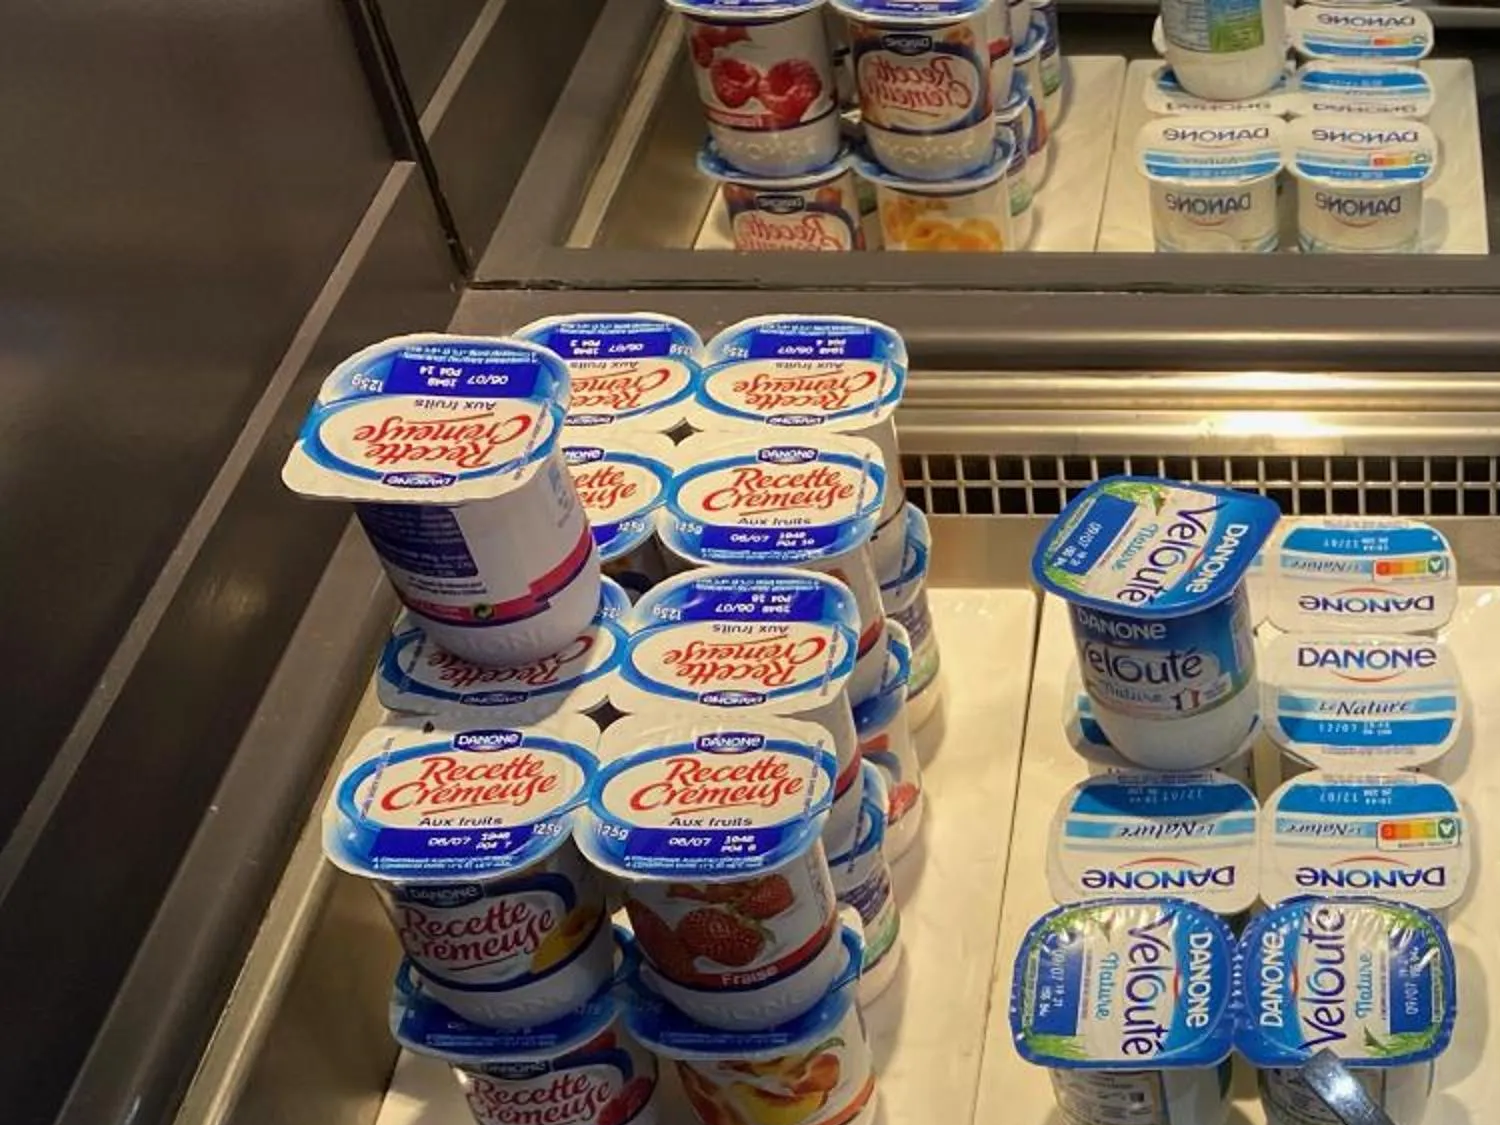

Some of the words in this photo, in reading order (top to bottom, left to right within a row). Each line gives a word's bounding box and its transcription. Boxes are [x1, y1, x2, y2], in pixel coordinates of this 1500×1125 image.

[745, 391, 851, 409] Recette
[365, 443, 494, 469] Recette
[731, 466, 840, 491] Recette
[1186, 523, 1249, 594] DANONE
[1299, 595, 1435, 613] DANONE
[1077, 607, 1167, 640] DANONE
[1297, 647, 1437, 669] DANONE
[676, 663, 797, 687] Recette
[1335, 700, 1411, 716] Nature
[415, 753, 545, 785] Recette
[664, 754, 791, 785] Recette
[1118, 823, 1203, 839] Nature
[1284, 822, 1351, 838] Nature
[1081, 866, 1235, 888] DANONE
[1295, 866, 1445, 888] DANONE
[398, 900, 528, 940] Recette
[721, 964, 779, 986] Fraise
[1121, 910, 1182, 1058] Velouté
[1185, 931, 1213, 1028] DANONE
[1260, 931, 1286, 1028] DANONE
